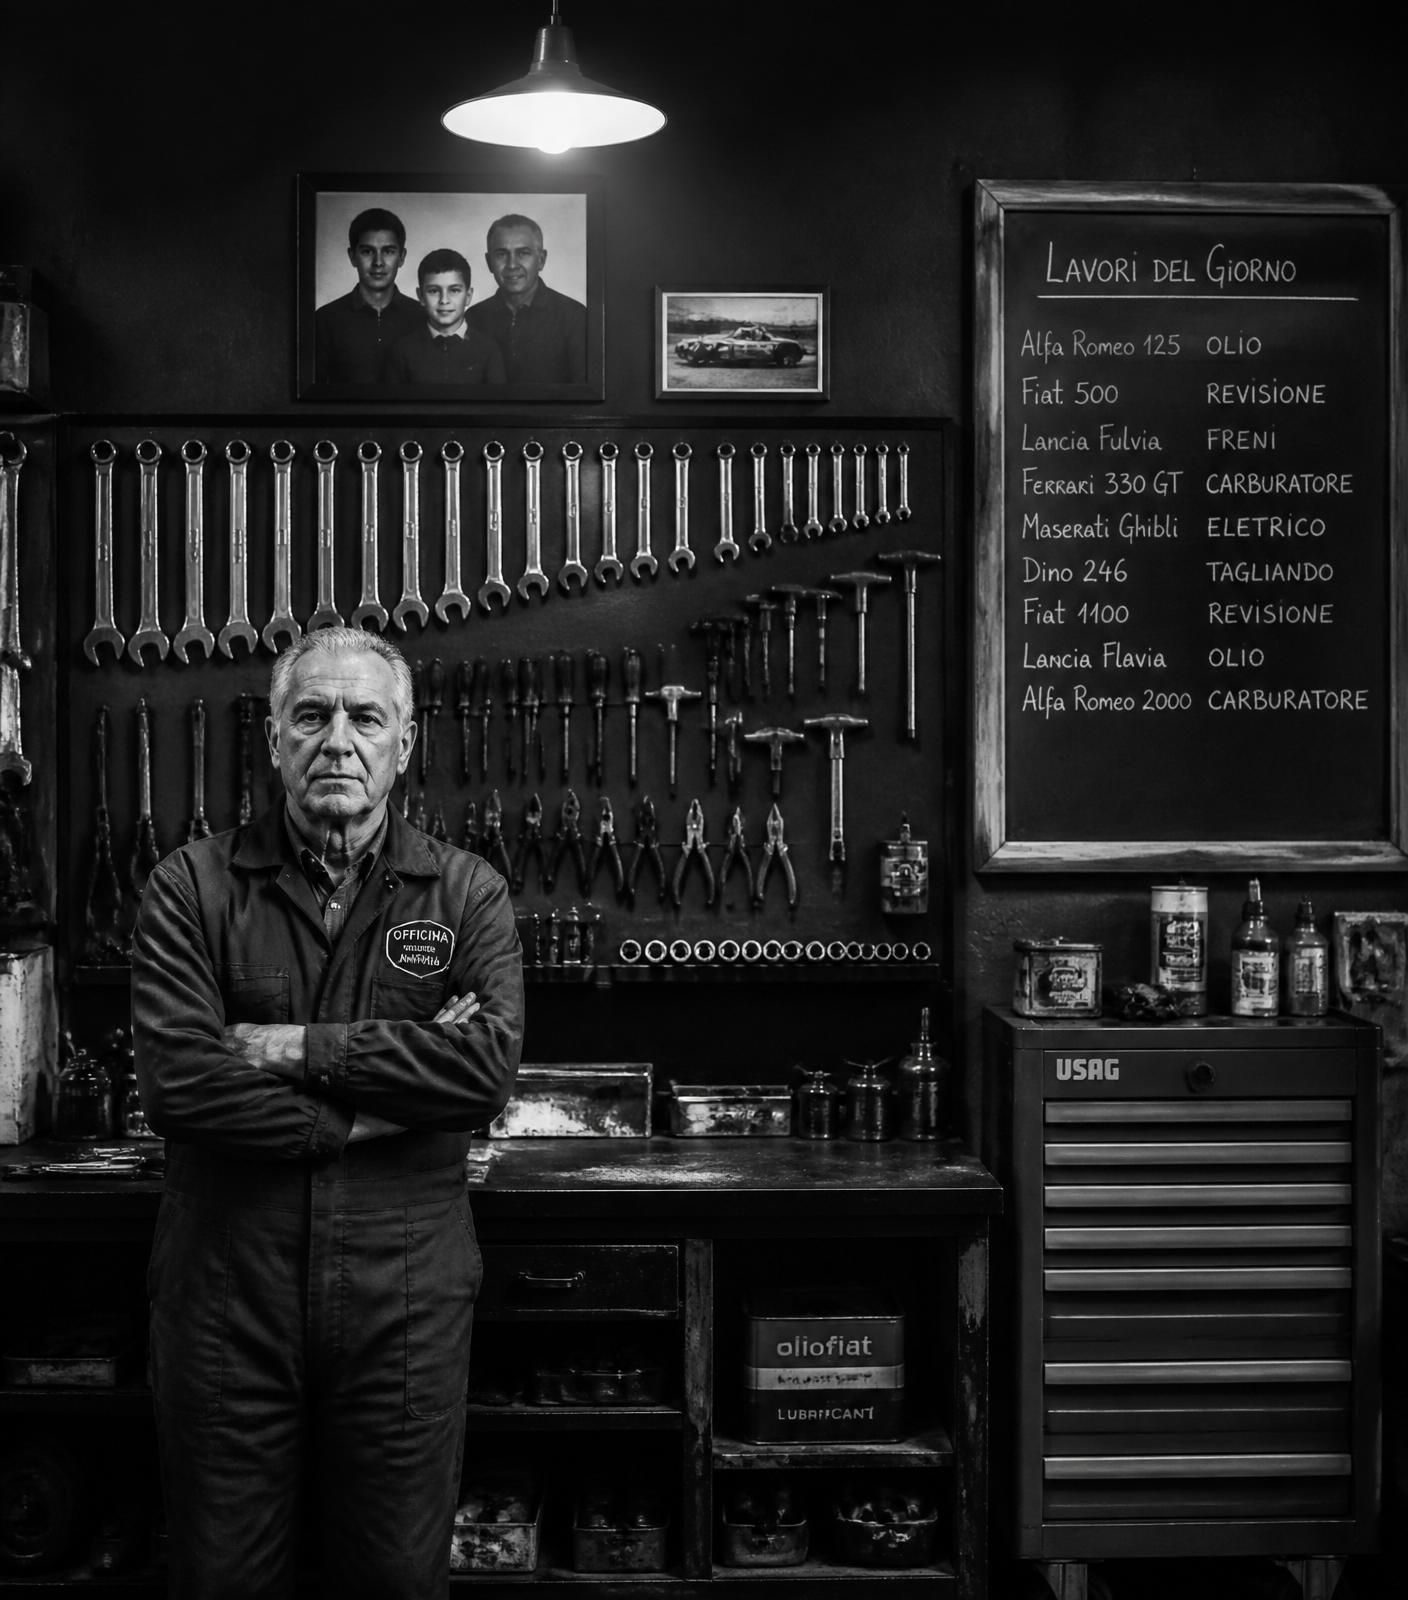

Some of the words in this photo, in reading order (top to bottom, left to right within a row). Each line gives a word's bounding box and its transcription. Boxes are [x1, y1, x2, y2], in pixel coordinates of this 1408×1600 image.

[1153, 260, 1195, 282] DEL
[1021, 330, 1064, 363] Alfa
[1073, 330, 1134, 357] Romeo
[1144, 334, 1180, 355] 125
[1207, 331, 1261, 354] OLIO
[1023, 376, 1063, 404] Fiat
[1075, 382, 1118, 404] 500
[1207, 378, 1325, 404] REVISIONE
[1022, 424, 1089, 451] Lancia
[1100, 424, 1162, 450] Fulvia
[1208, 425, 1276, 451] FRENI
[1023, 467, 1093, 495] Ferrari
[1105, 473, 1146, 494] 330
[1153, 470, 1183, 496] GT
[1206, 473, 1352, 494] CARBURATORE
[1022, 513, 1109, 540] Maserati
[1119, 513, 1178, 544] Ghibli
[1208, 513, 1325, 537] ELETRICO
[1023, 557, 1073, 582] Dino
[1083, 558, 1127, 582] 246
[1206, 561, 1333, 583] TAGLIANDO
[1024, 597, 1065, 624] Fiat
[1078, 603, 1129, 624] 1100
[1209, 600, 1333, 624] REVISIONE
[1024, 642, 1092, 669] Lancia
[1103, 641, 1167, 668] Flavia
[1208, 643, 1265, 668] OLIO
[1022, 685, 1065, 719] Alfa
[1074, 685, 1135, 711] Romeo
[1142, 689, 1191, 711] 2000
[1208, 689, 1368, 710] CARBURATORE
[1057, 1059, 1119, 1080] USAG
[777, 1336, 872, 1356] oliofiat
